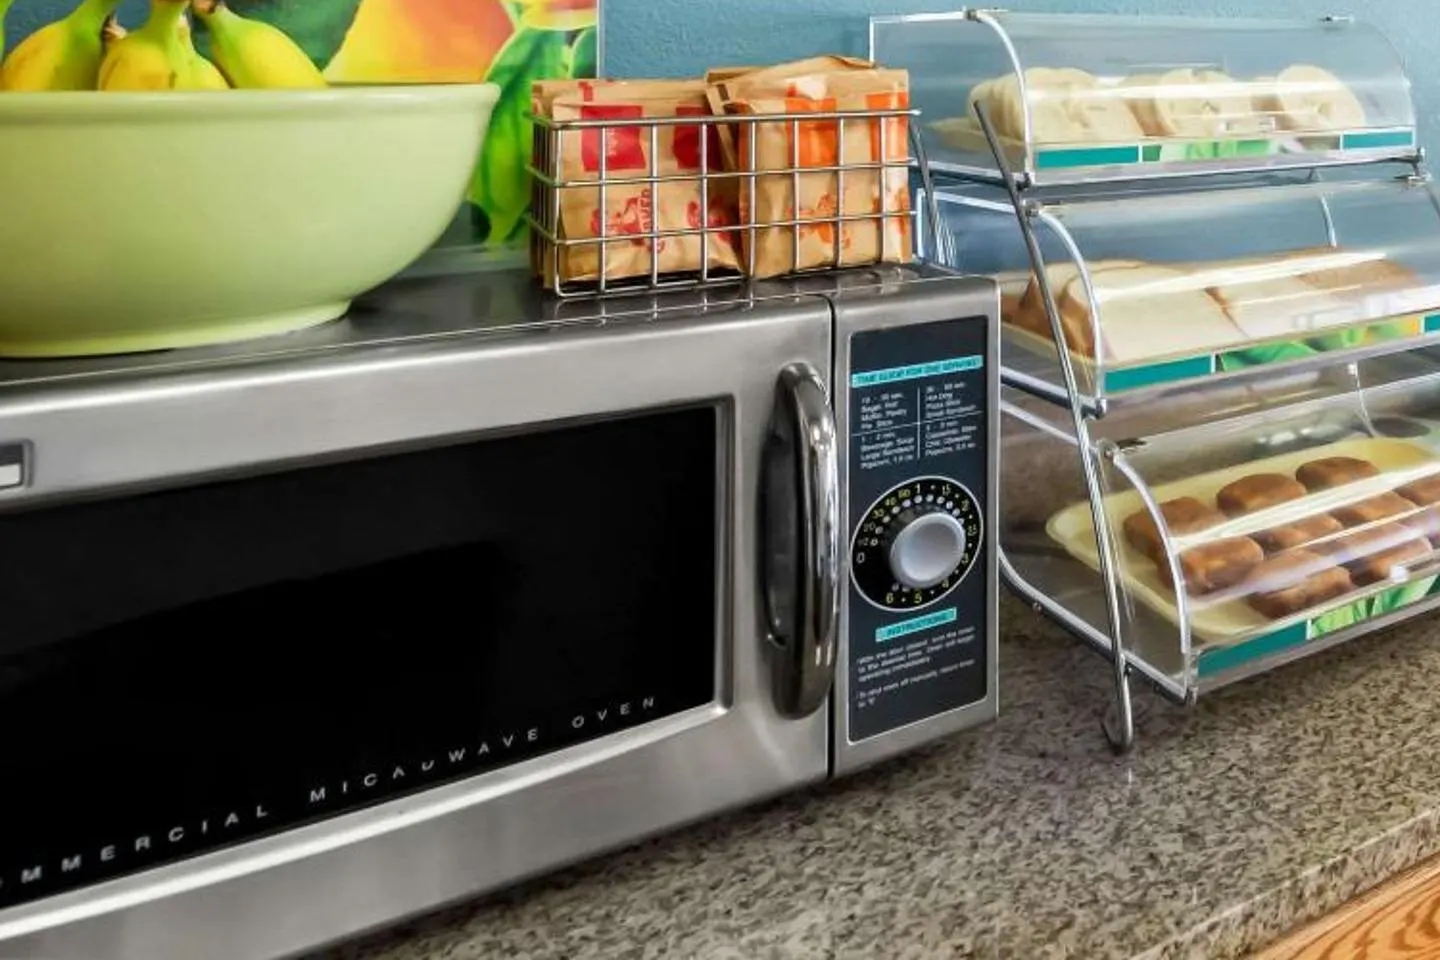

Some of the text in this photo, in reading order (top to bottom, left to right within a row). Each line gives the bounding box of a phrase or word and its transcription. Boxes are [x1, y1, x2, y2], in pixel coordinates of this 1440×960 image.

[886, 592, 894, 604] 6
[0, 805, 268, 888] MMERCIAL
[571, 696, 655, 729] OVEN
